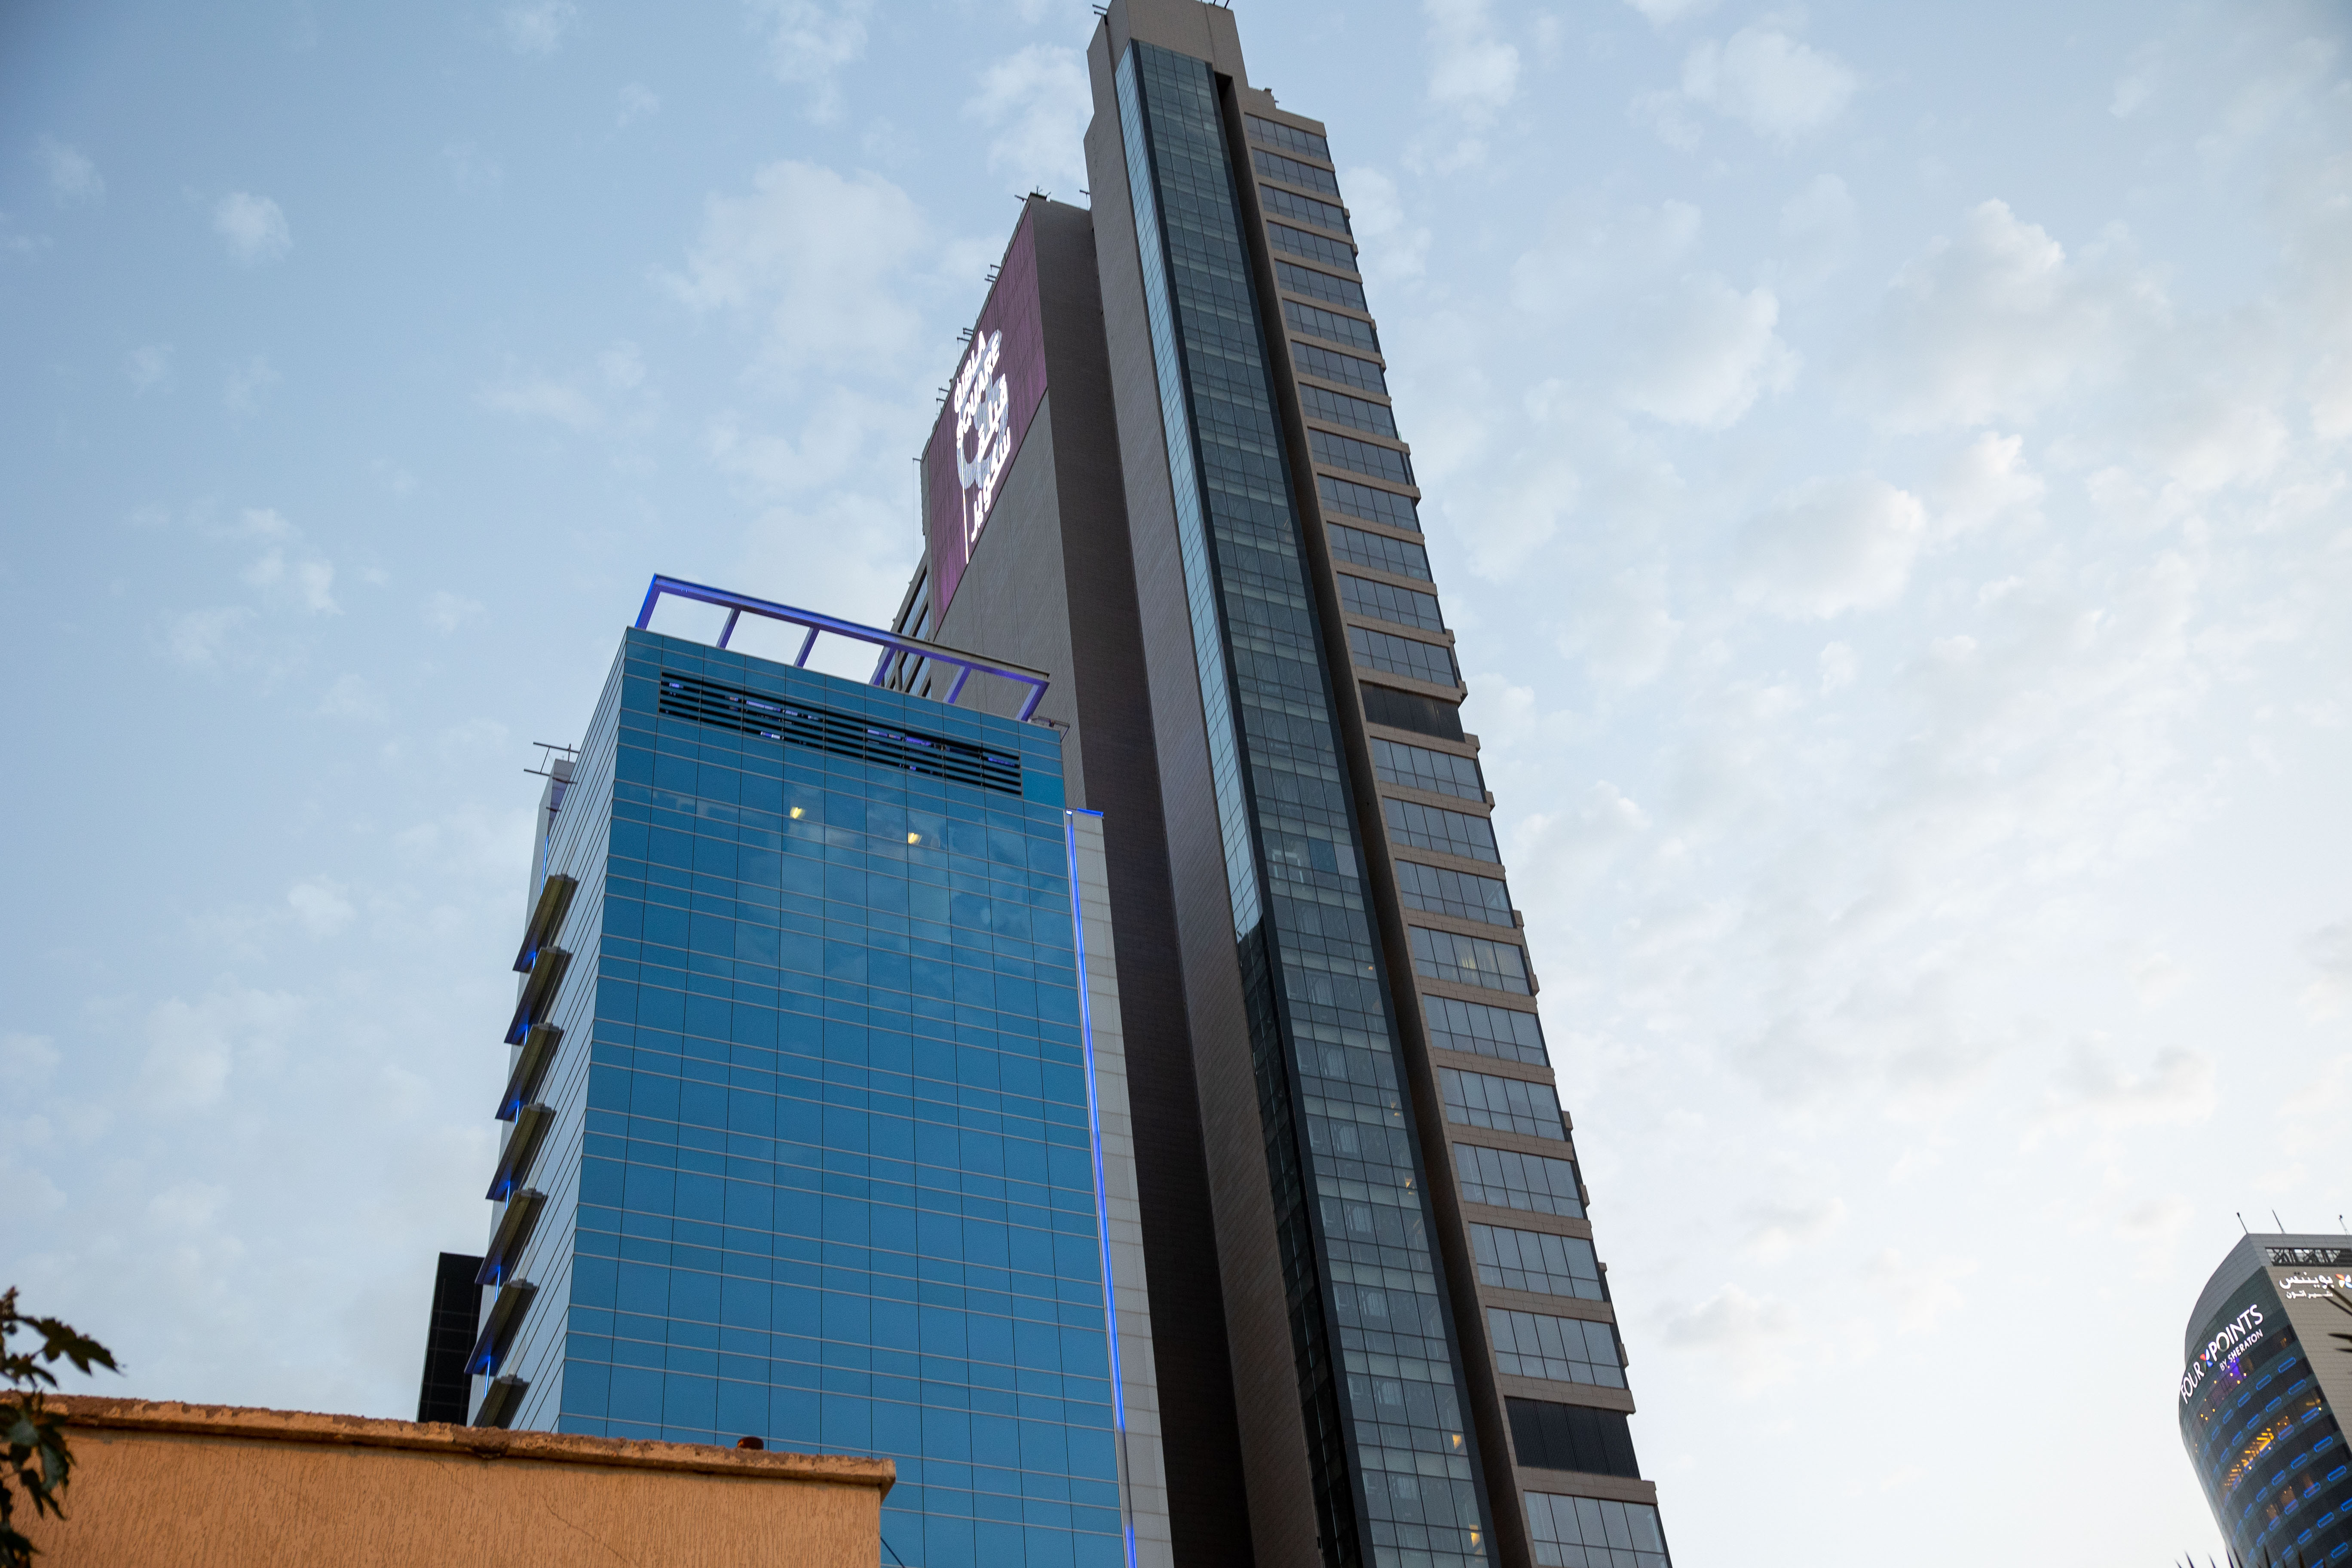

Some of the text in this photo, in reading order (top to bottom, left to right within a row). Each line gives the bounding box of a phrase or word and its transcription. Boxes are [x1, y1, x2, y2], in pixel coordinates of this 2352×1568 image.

[954, 331, 986, 413] QIBLA
[956, 332, 1000, 449] SQUARE
[977, 373, 1008, 463] قبلة
[971, 427, 1011, 543] سكوير
[2180, 1304, 2263, 1405] FOUR POINTS
[2219, 1329, 2263, 1372] BY SHERATON
